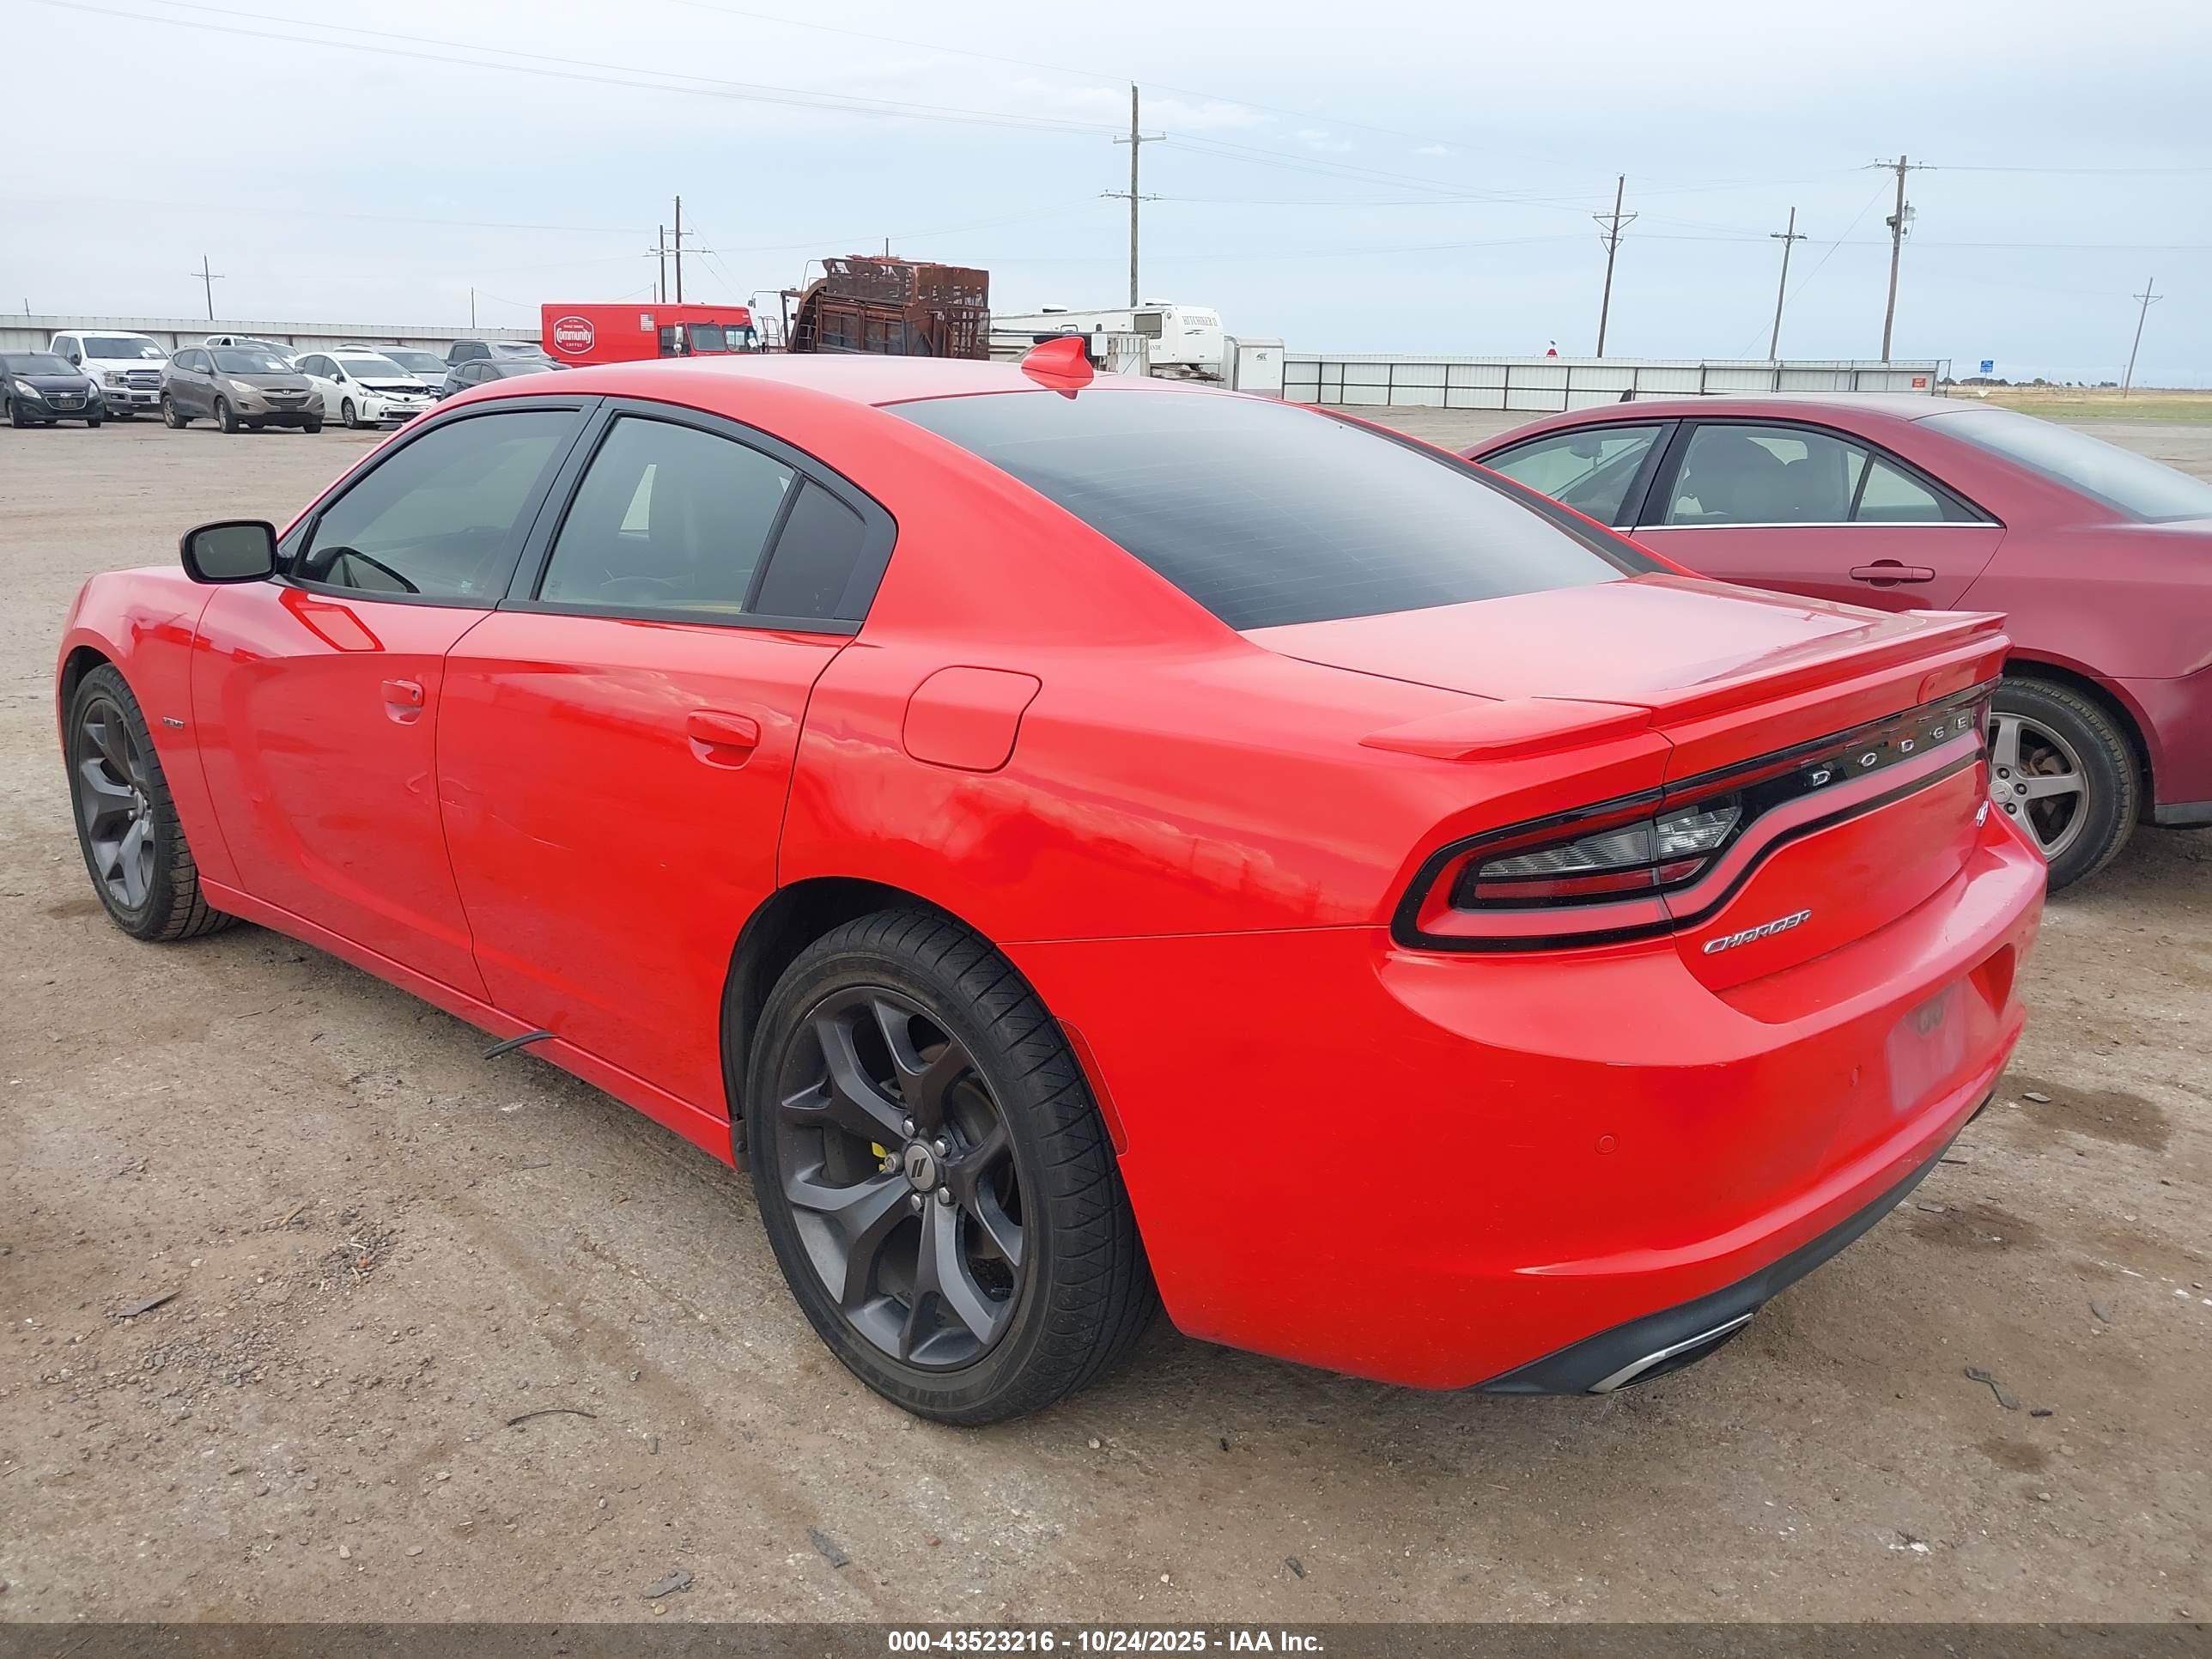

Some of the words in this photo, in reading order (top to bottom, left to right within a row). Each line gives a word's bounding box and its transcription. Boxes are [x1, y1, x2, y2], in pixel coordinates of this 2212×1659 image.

[556, 328, 591, 343] Community
[1812, 716, 1967, 787] DODGE
[1704, 909, 1811, 955] CHARGER
